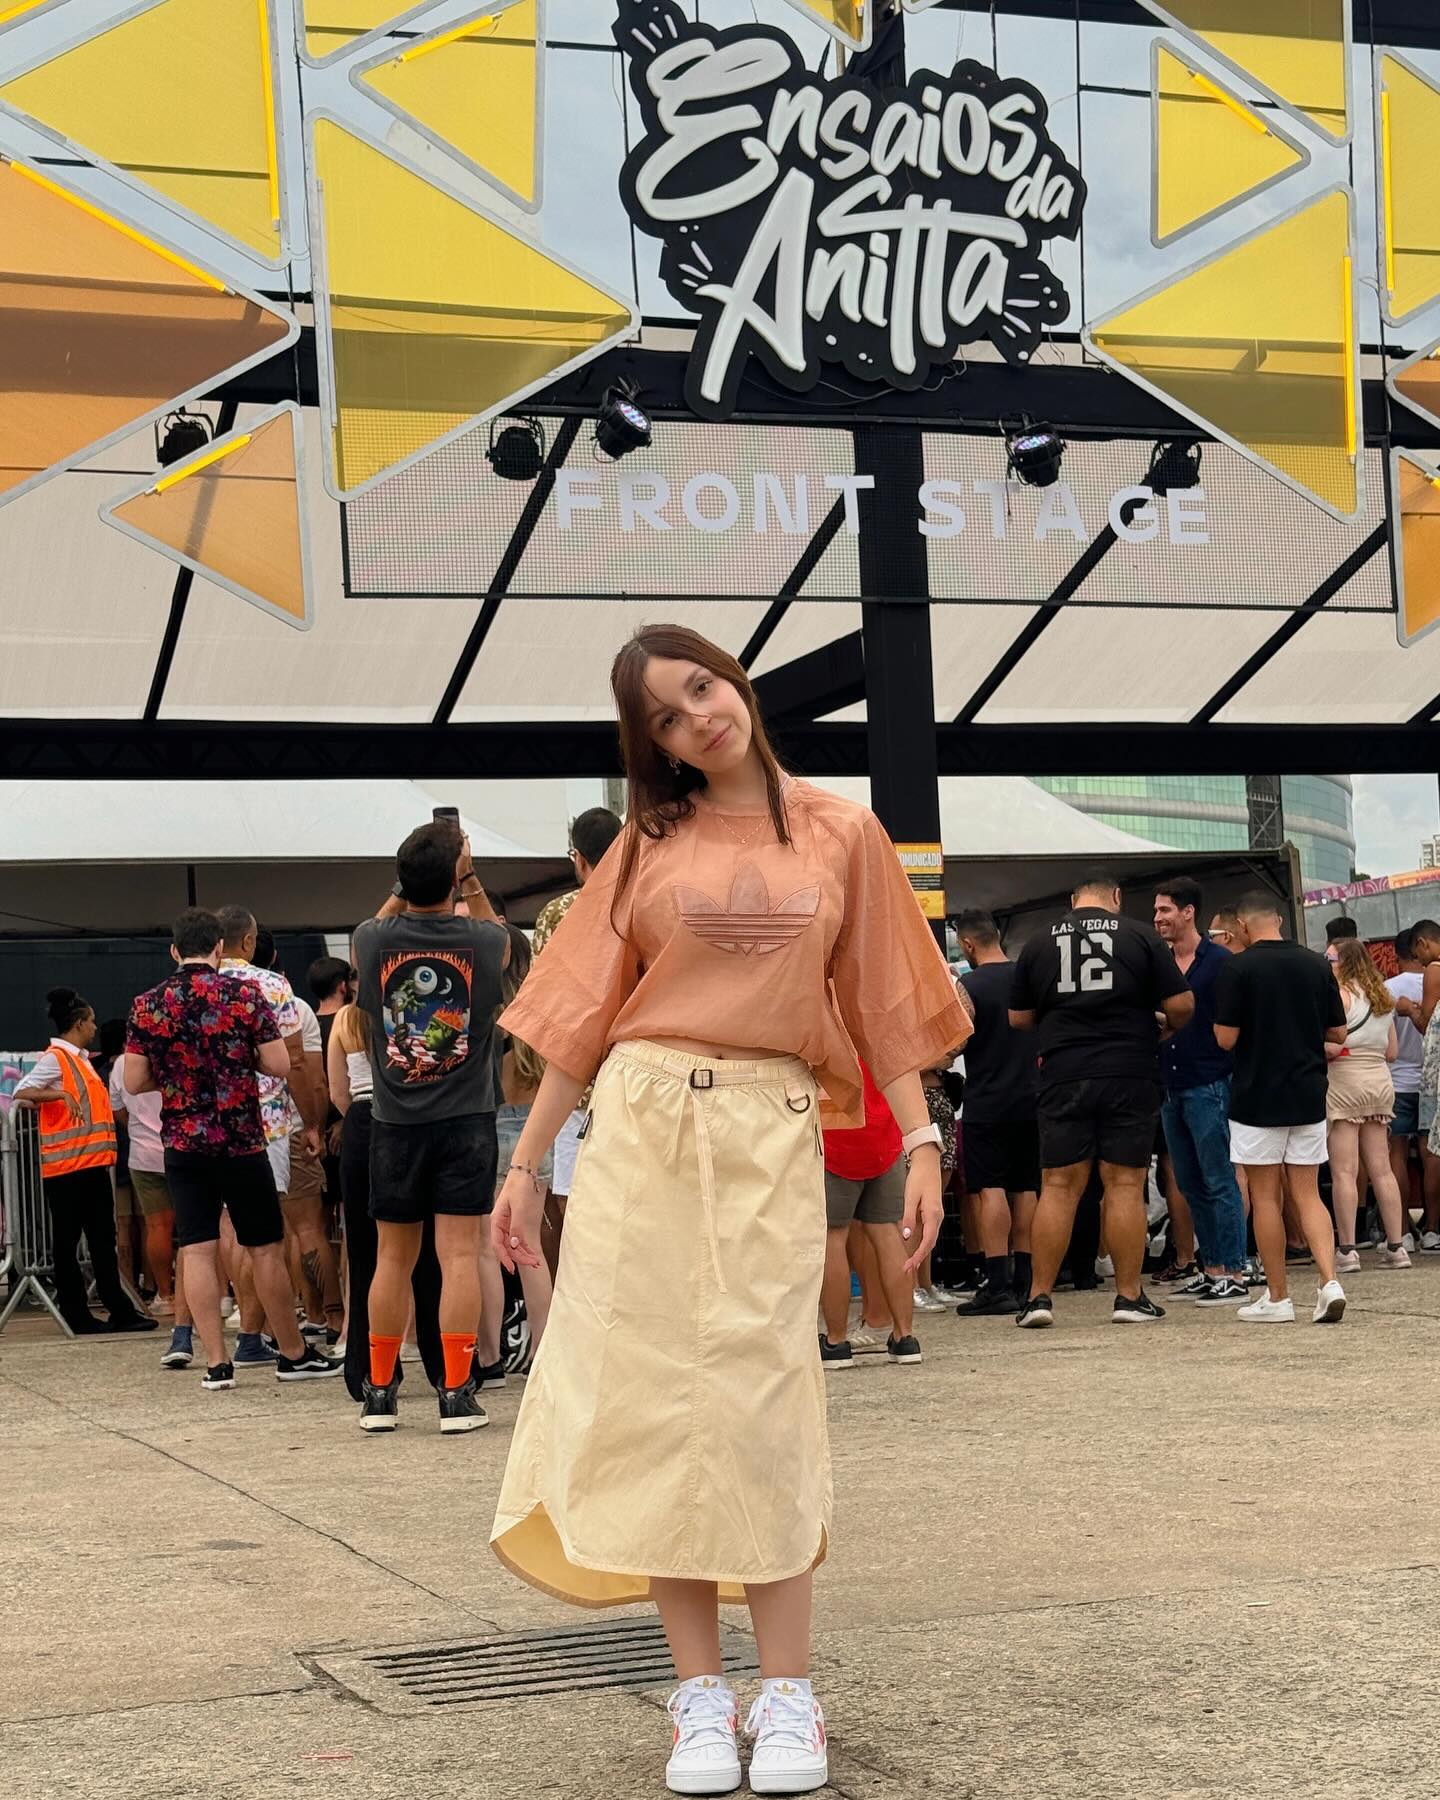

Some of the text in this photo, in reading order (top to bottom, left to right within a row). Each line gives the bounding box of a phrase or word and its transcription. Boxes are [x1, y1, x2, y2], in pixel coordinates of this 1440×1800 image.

[635, 37, 1075, 223] Ensaios da
[696, 167, 1028, 403] Anitta
[555, 468, 1211, 545] FRONT STAGE
[897, 852, 942, 867] OMUNICADO
[1051, 922, 1075, 936] LAS
[1056, 931, 1113, 993] 12
